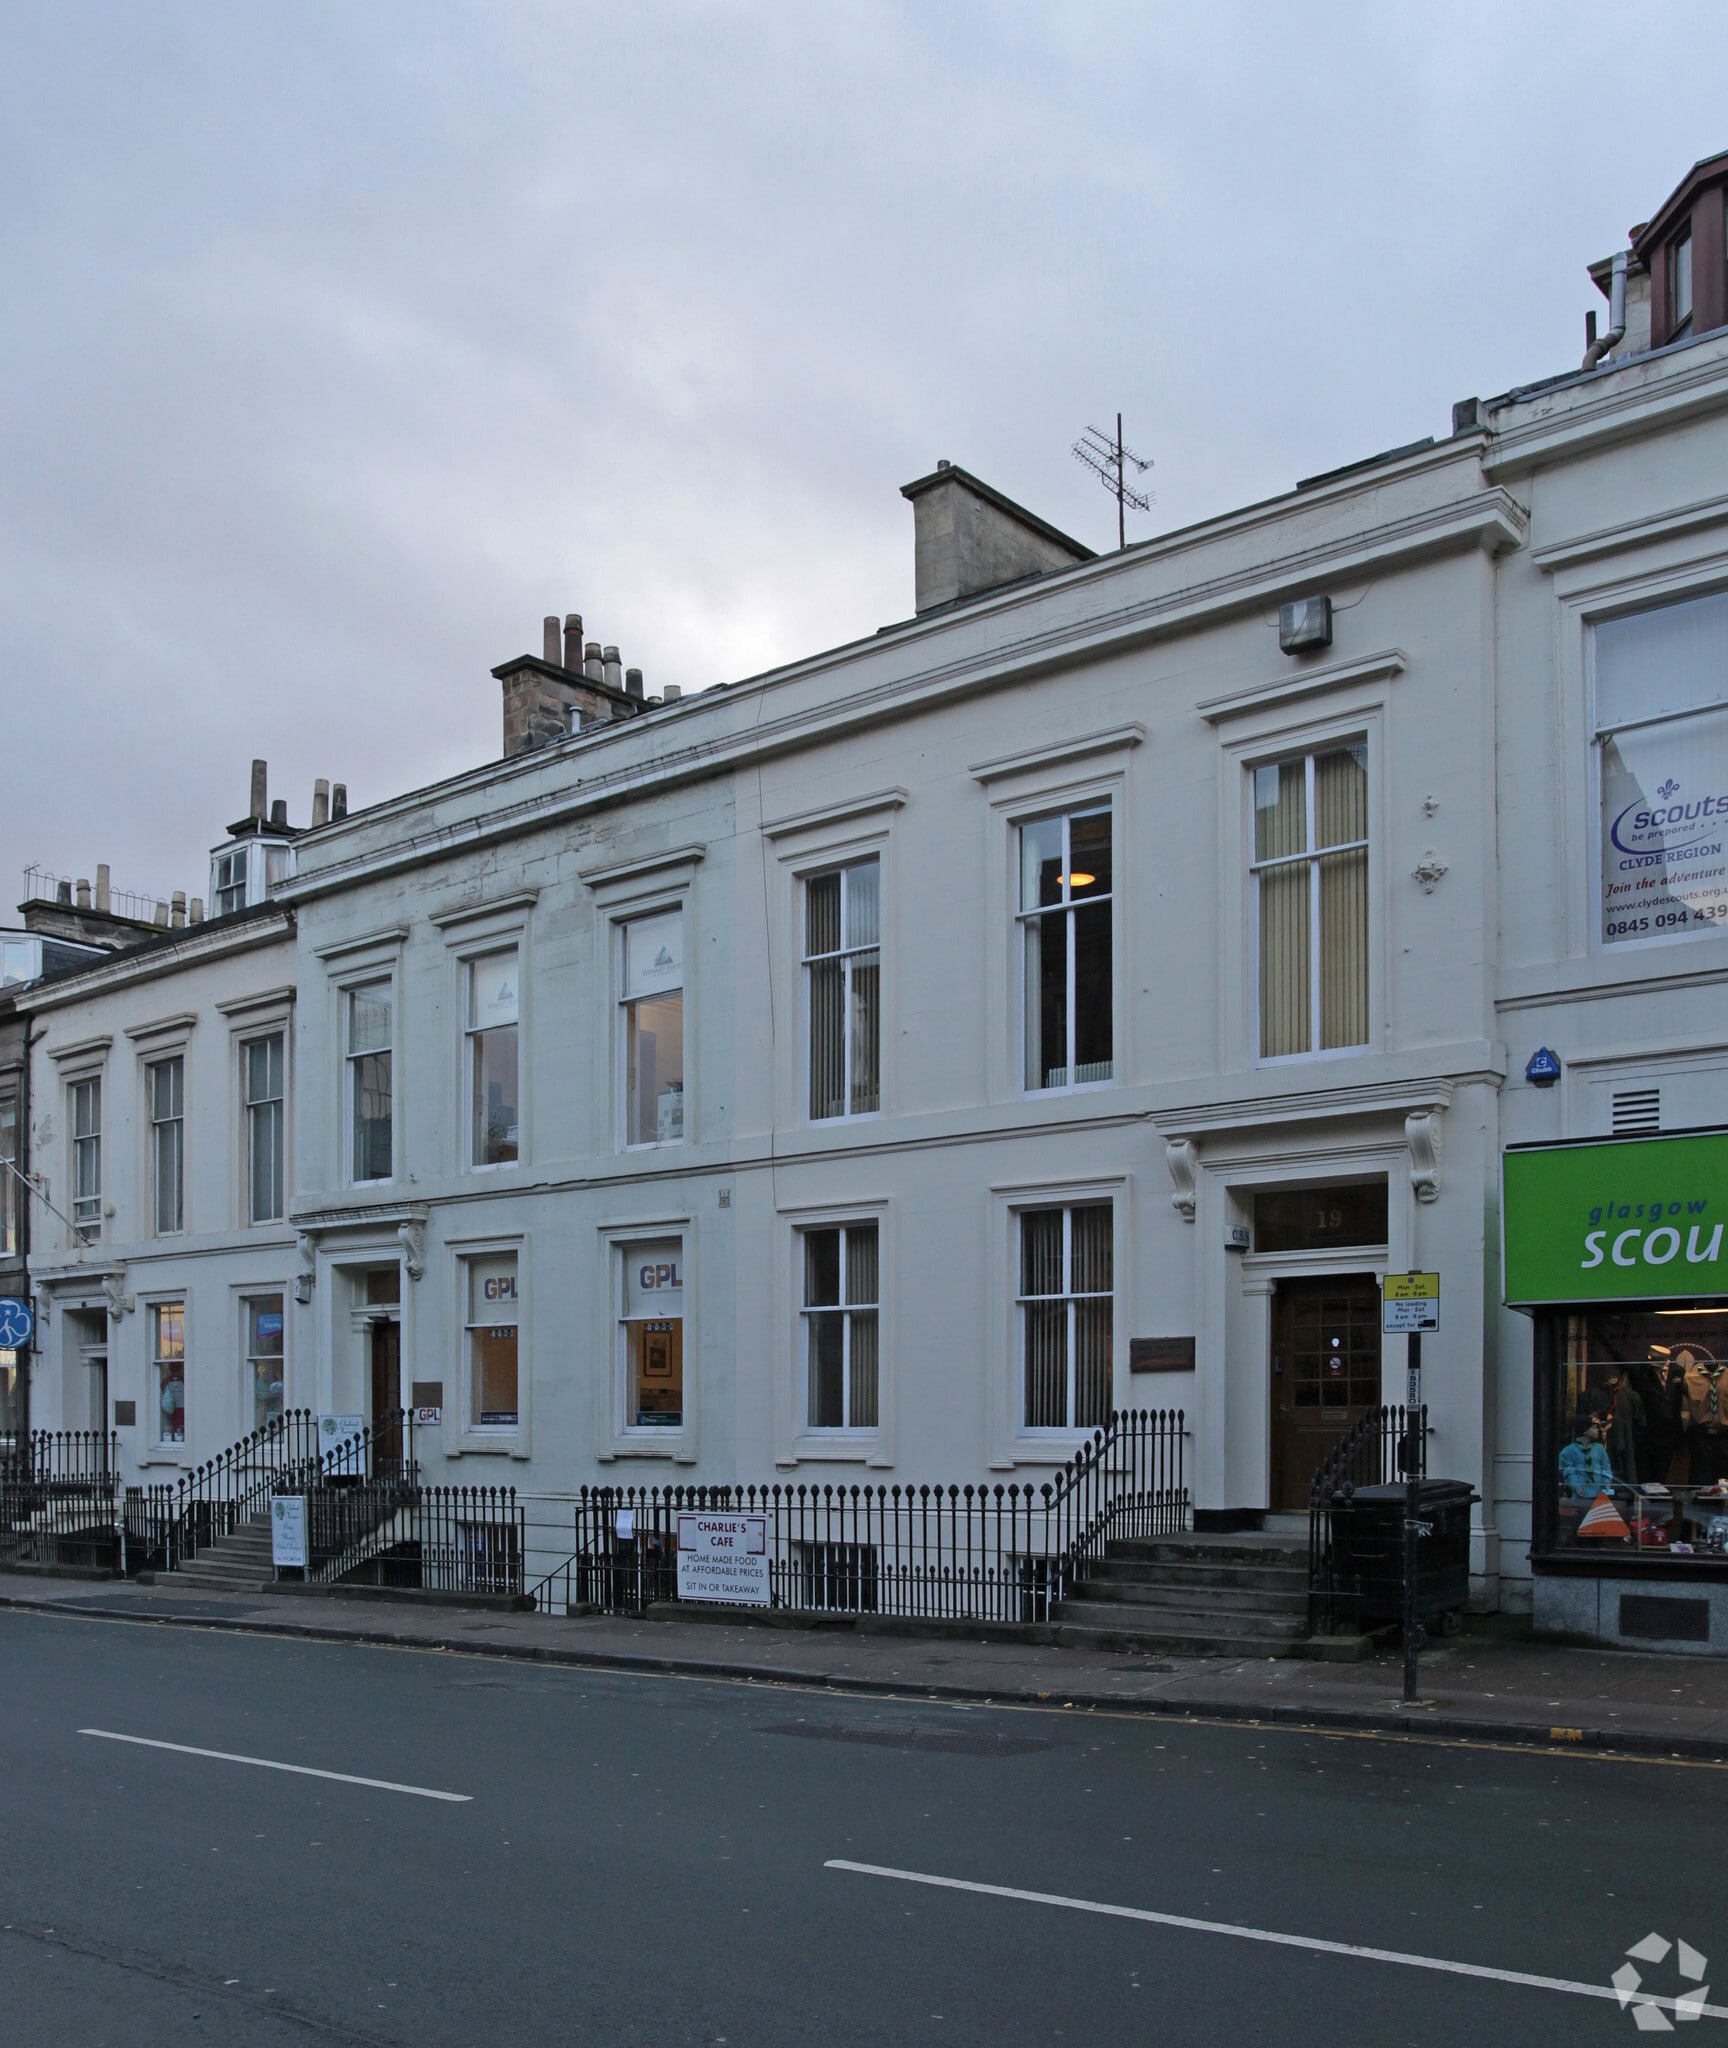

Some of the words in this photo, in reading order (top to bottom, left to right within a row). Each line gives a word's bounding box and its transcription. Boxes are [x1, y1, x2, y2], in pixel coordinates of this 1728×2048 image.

[1631, 831, 1644, 842] be
[1619, 854, 1662, 871] CLYDE
[1666, 843, 1722, 863] REGION
[1606, 881, 1631, 898] Join
[1636, 877, 1656, 890] the
[1660, 866, 1726, 886] adventure
[1606, 917, 1649, 936] 0845
[1655, 911, 1688, 928] 094
[1316, 1209, 1342, 1229] 19
[1588, 1200, 1708, 1226] glasgow
[640, 1264, 683, 1289] GPL
[485, 1277, 518, 1300] GPL
[419, 1408, 440, 1421] GPL
[697, 1521, 747, 1533] CHARLIE'S
[710, 1536, 734, 1547] CAFE
[687, 1554, 710, 1563] HOME
[711, 1555, 733, 1565] MADE
[734, 1556, 757, 1566] FOOD
[681, 1564, 690, 1573] AT
[692, 1565, 737, 1576] AFFORDABLE
[739, 1568, 764, 1578] PRICES
[686, 1581, 696, 1591] SIT
[698, 1583, 707, 1591] IN
[708, 1583, 720, 1592] OR
[722, 1584, 760, 1595] TAKEAWAY
